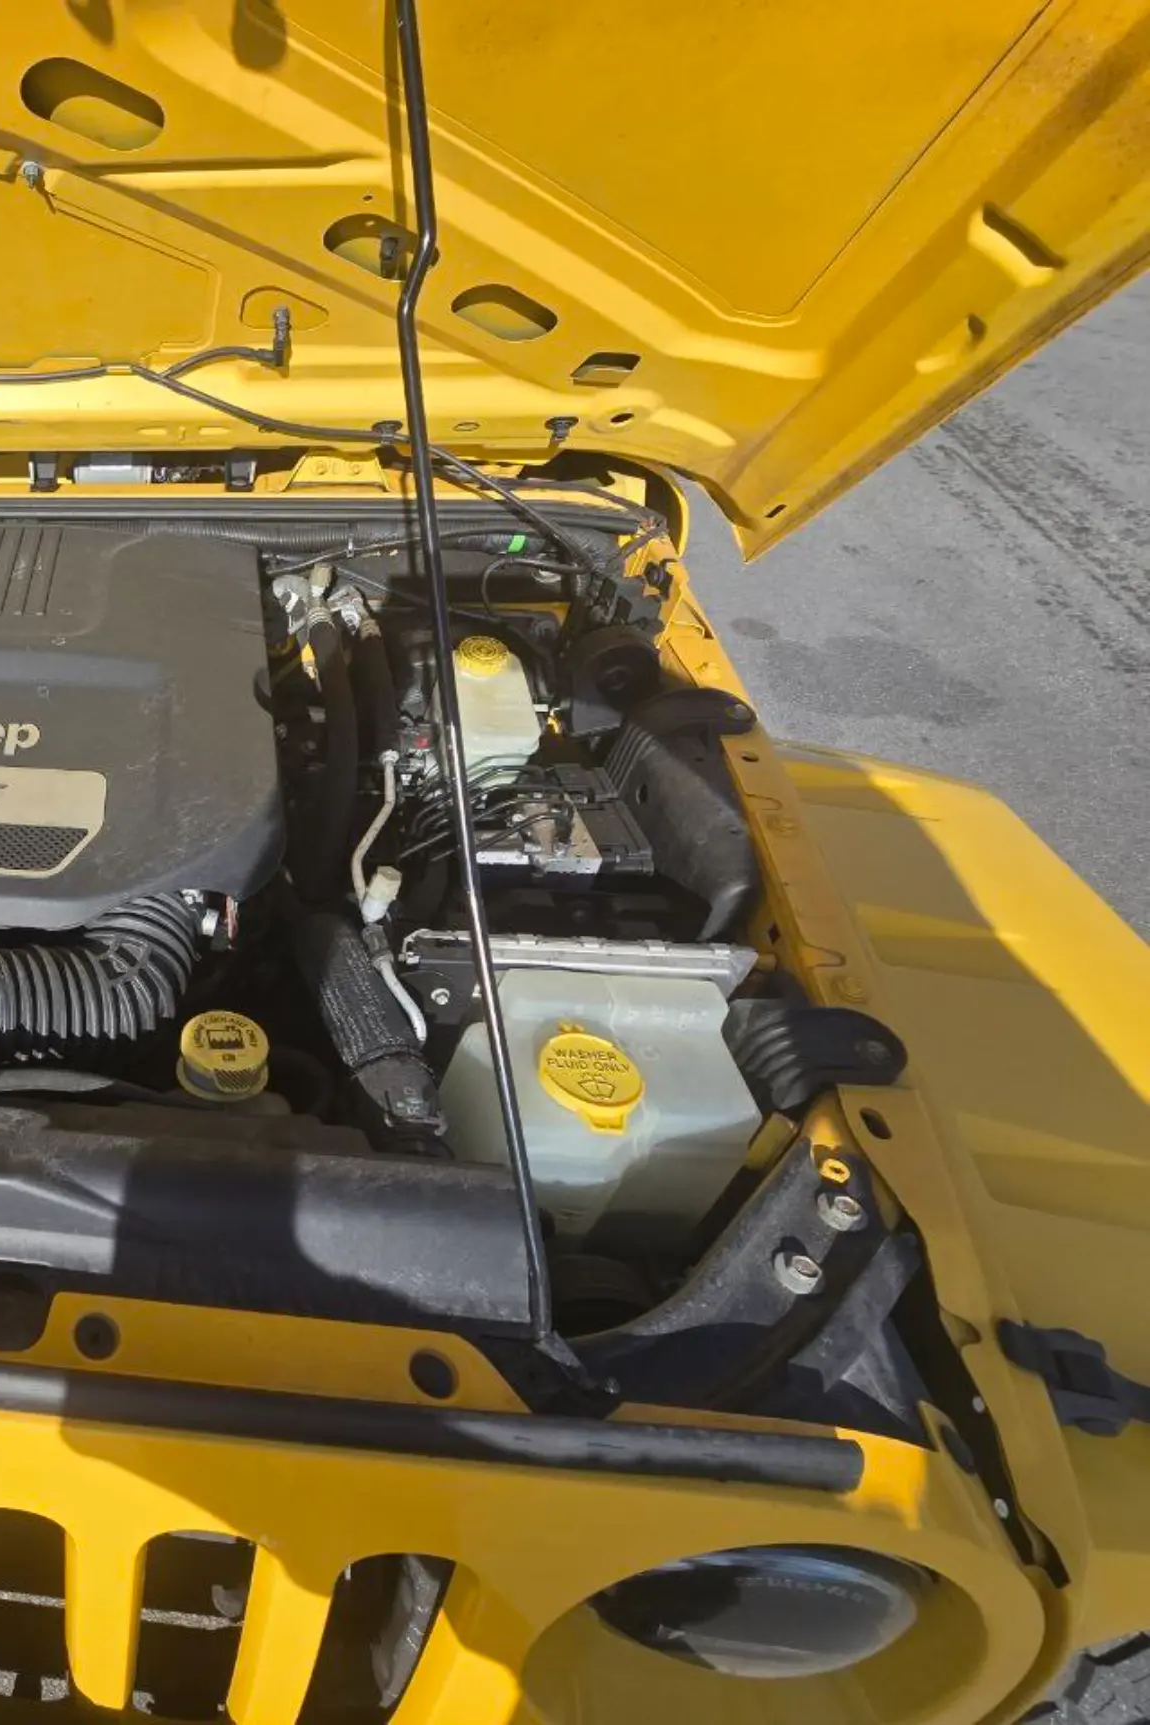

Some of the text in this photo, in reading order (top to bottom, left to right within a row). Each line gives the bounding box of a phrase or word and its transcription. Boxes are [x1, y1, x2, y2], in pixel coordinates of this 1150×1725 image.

[553, 1049, 617, 1060] WASHER
[547, 1058, 630, 1074] FLUID ONLY
